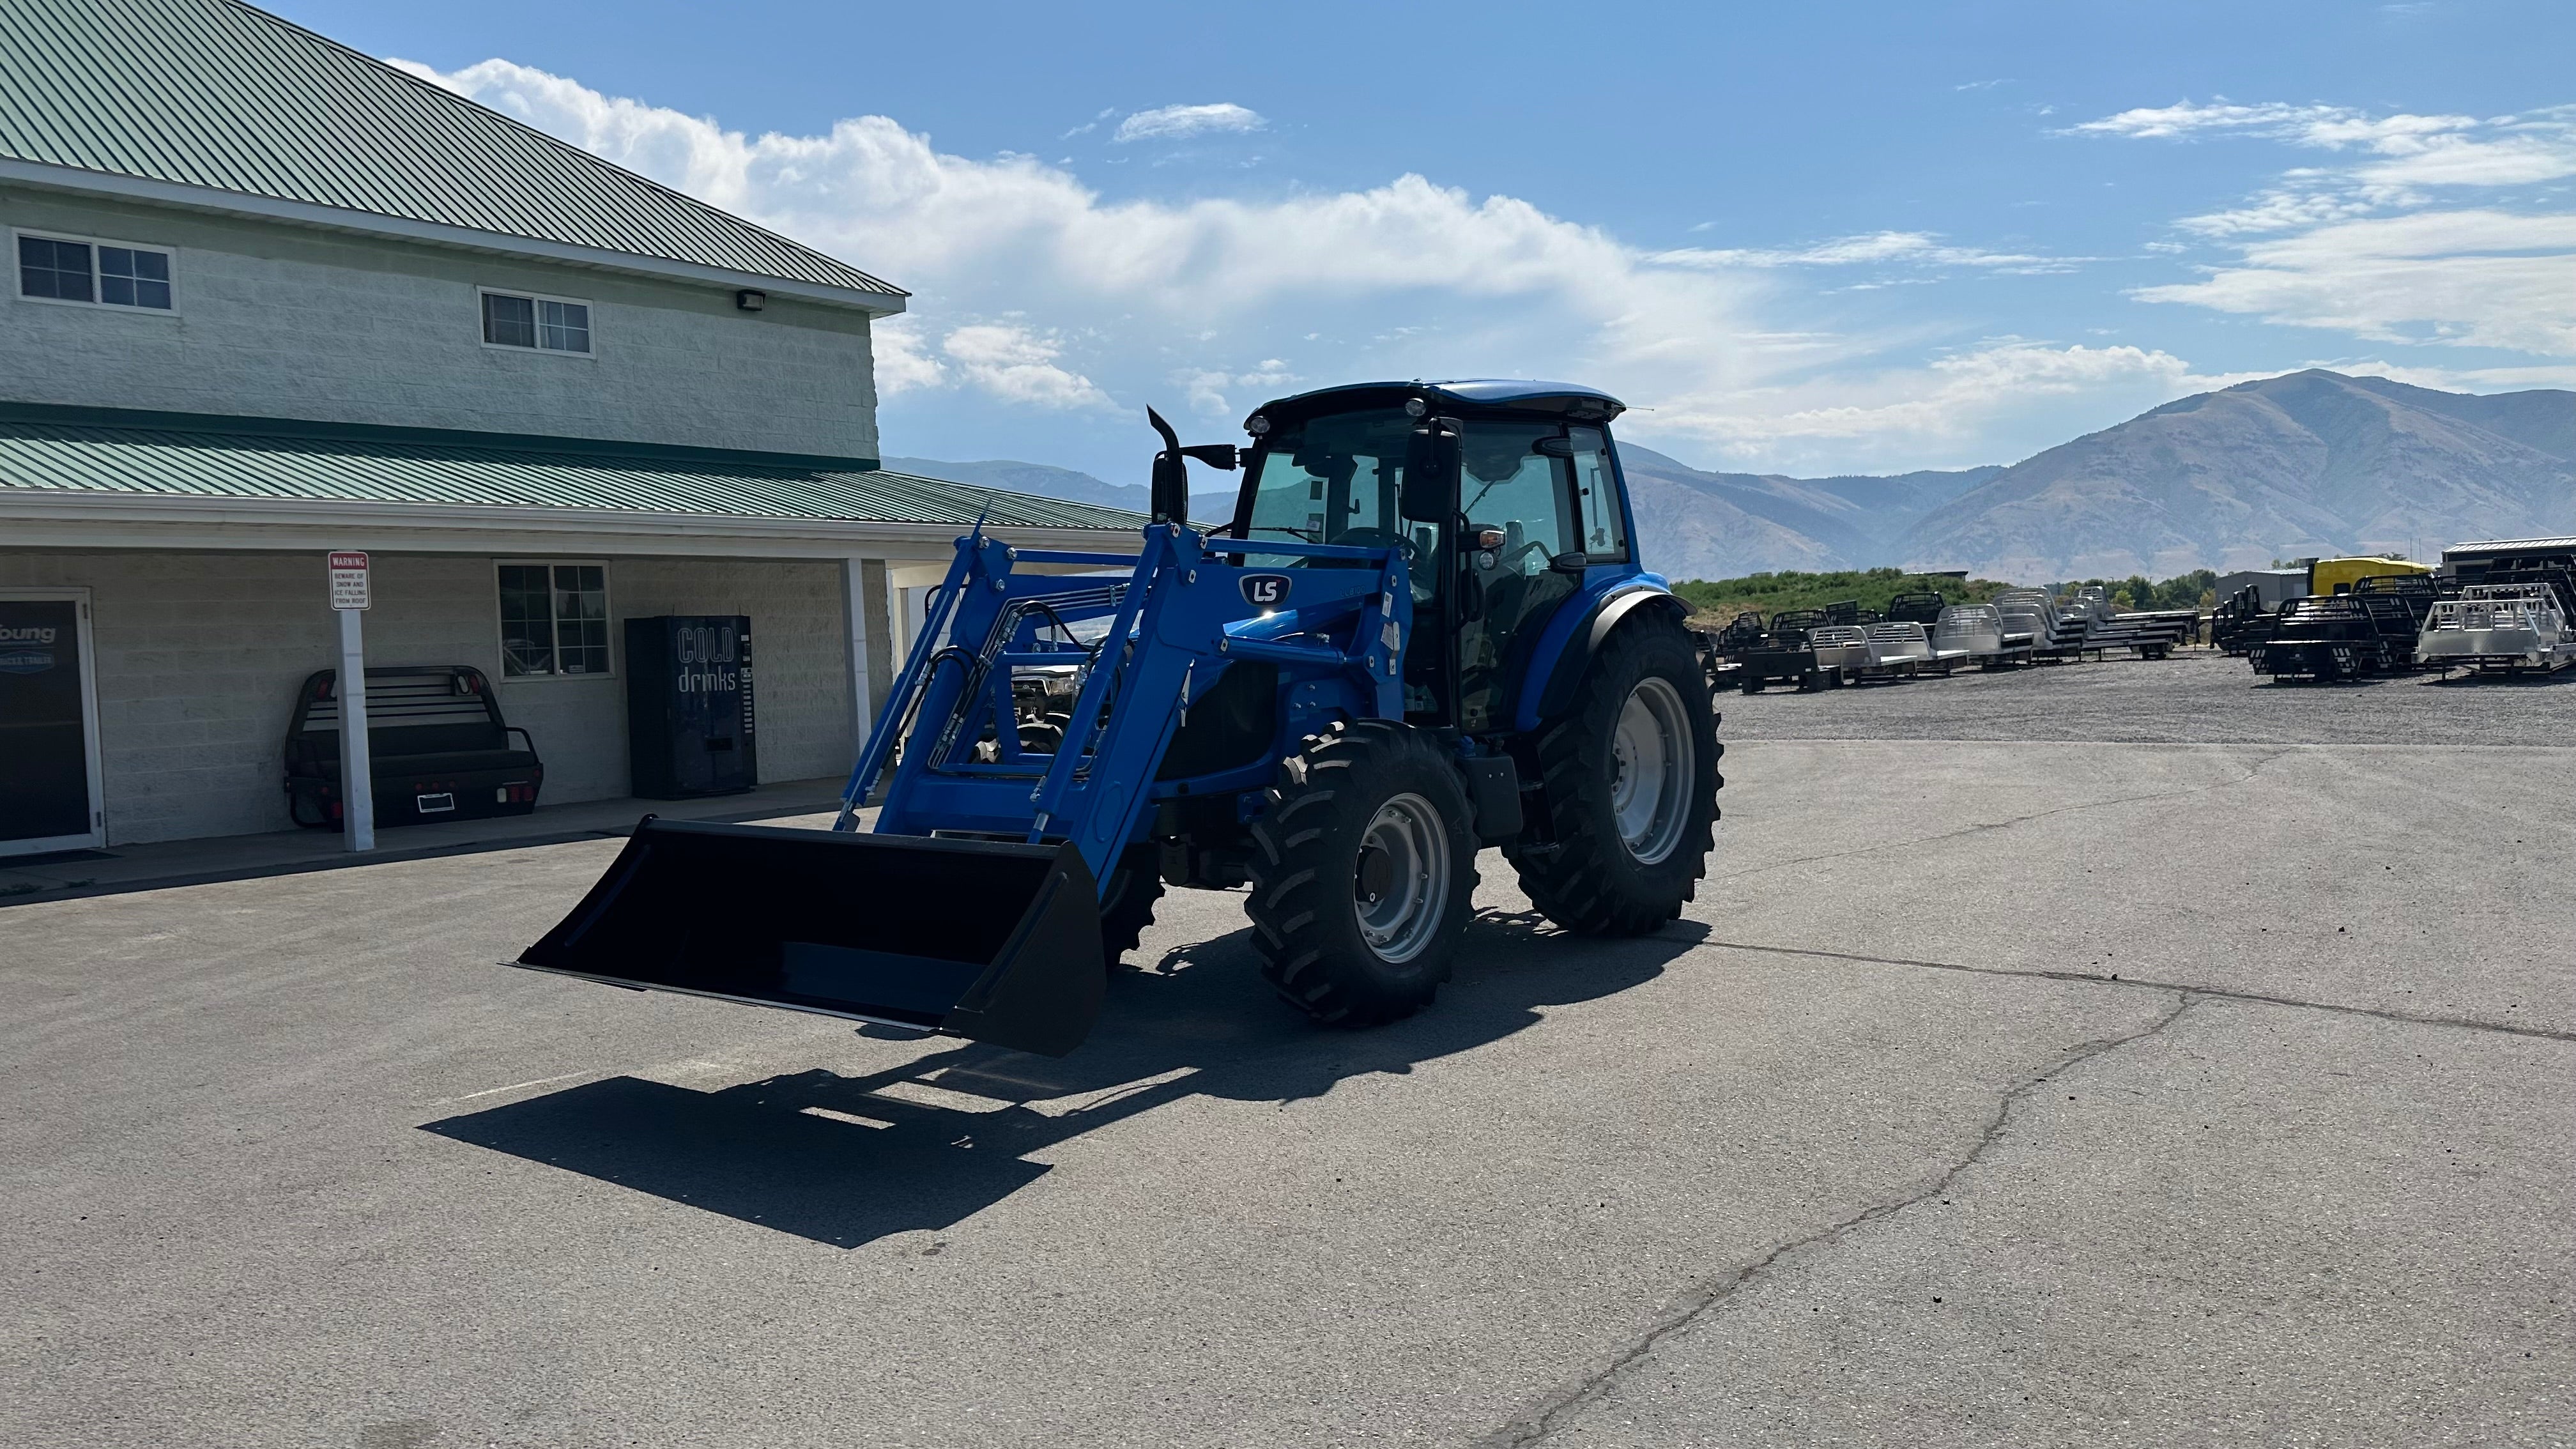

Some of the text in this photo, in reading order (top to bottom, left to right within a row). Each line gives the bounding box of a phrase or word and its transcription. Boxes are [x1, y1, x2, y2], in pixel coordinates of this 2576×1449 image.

[333, 557, 365, 567] WARNING
[1254, 581, 1277, 602] LS
[0, 624, 56, 643] oung
[678, 627, 734, 663] COLD
[678, 665, 735, 693] drinks
